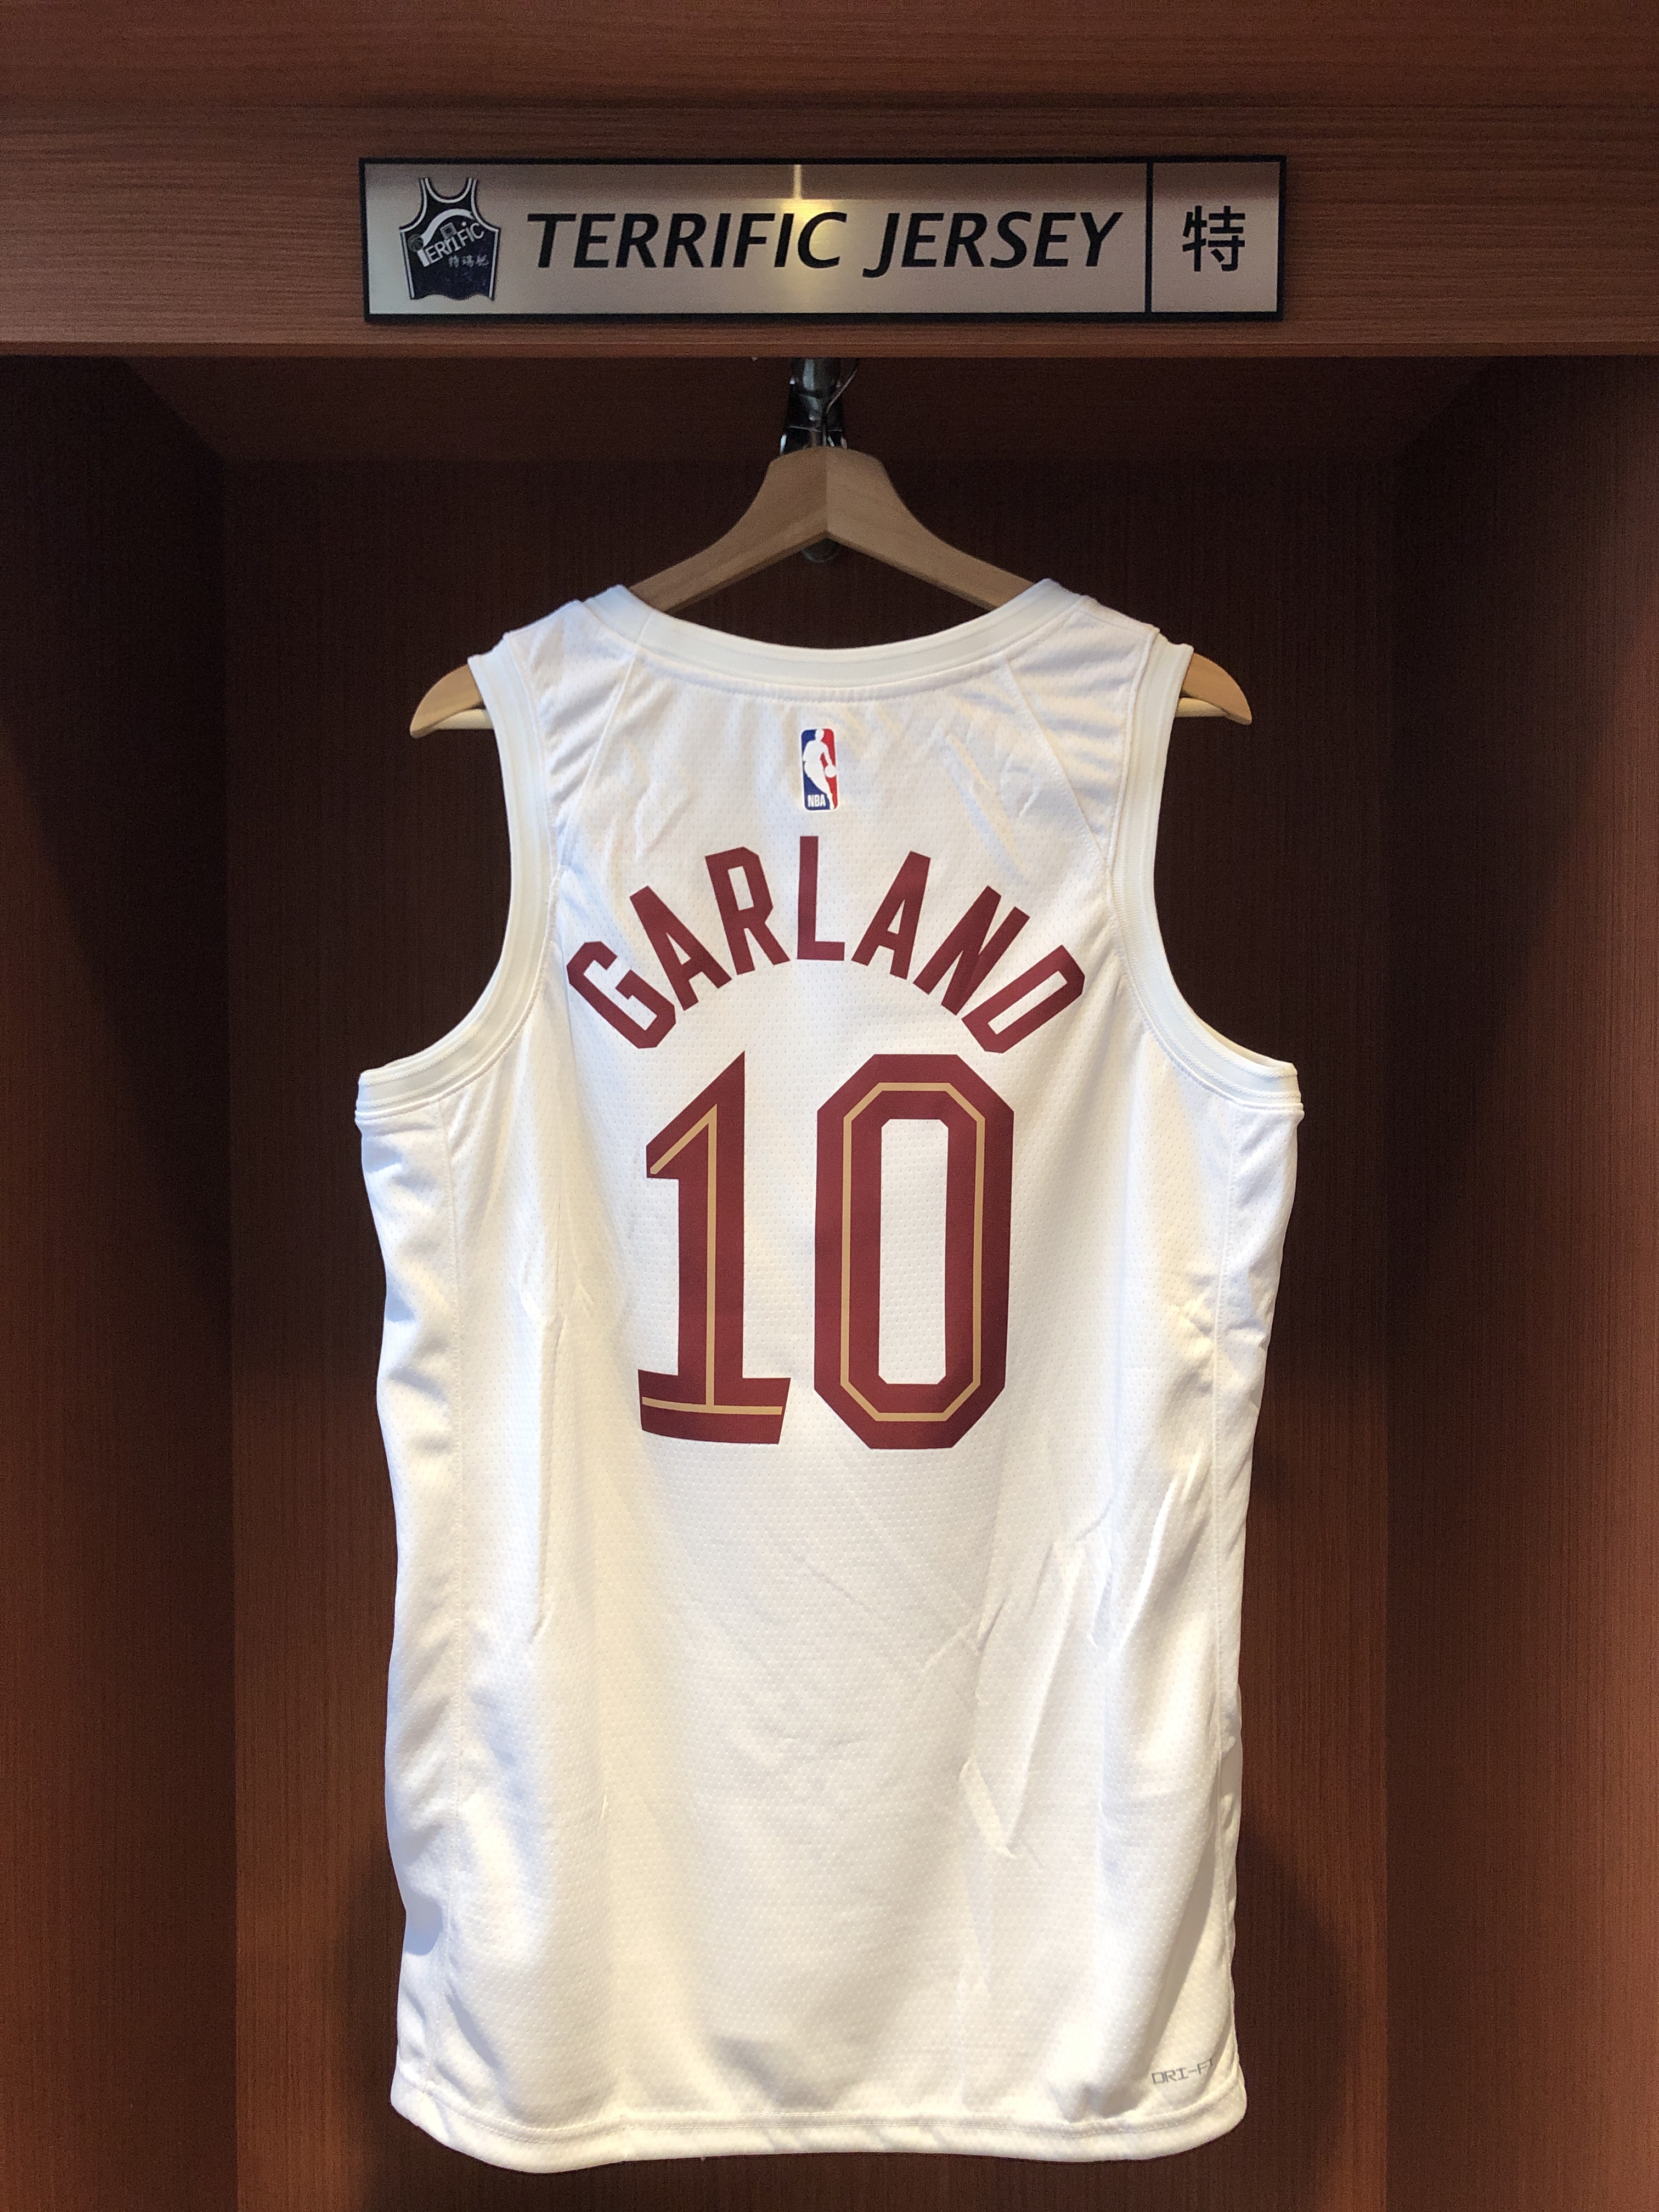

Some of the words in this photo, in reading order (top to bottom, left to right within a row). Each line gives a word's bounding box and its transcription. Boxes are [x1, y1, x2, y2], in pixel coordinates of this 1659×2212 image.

[527, 212, 847, 269] TERRIFIC
[862, 211, 1124, 278] JERSEY
[1182, 205, 1246, 272] 特
[807, 794, 826, 807] NBA
[567, 836, 1085, 1053] GARLAND
[637, 1051, 1014, 1450] 10
